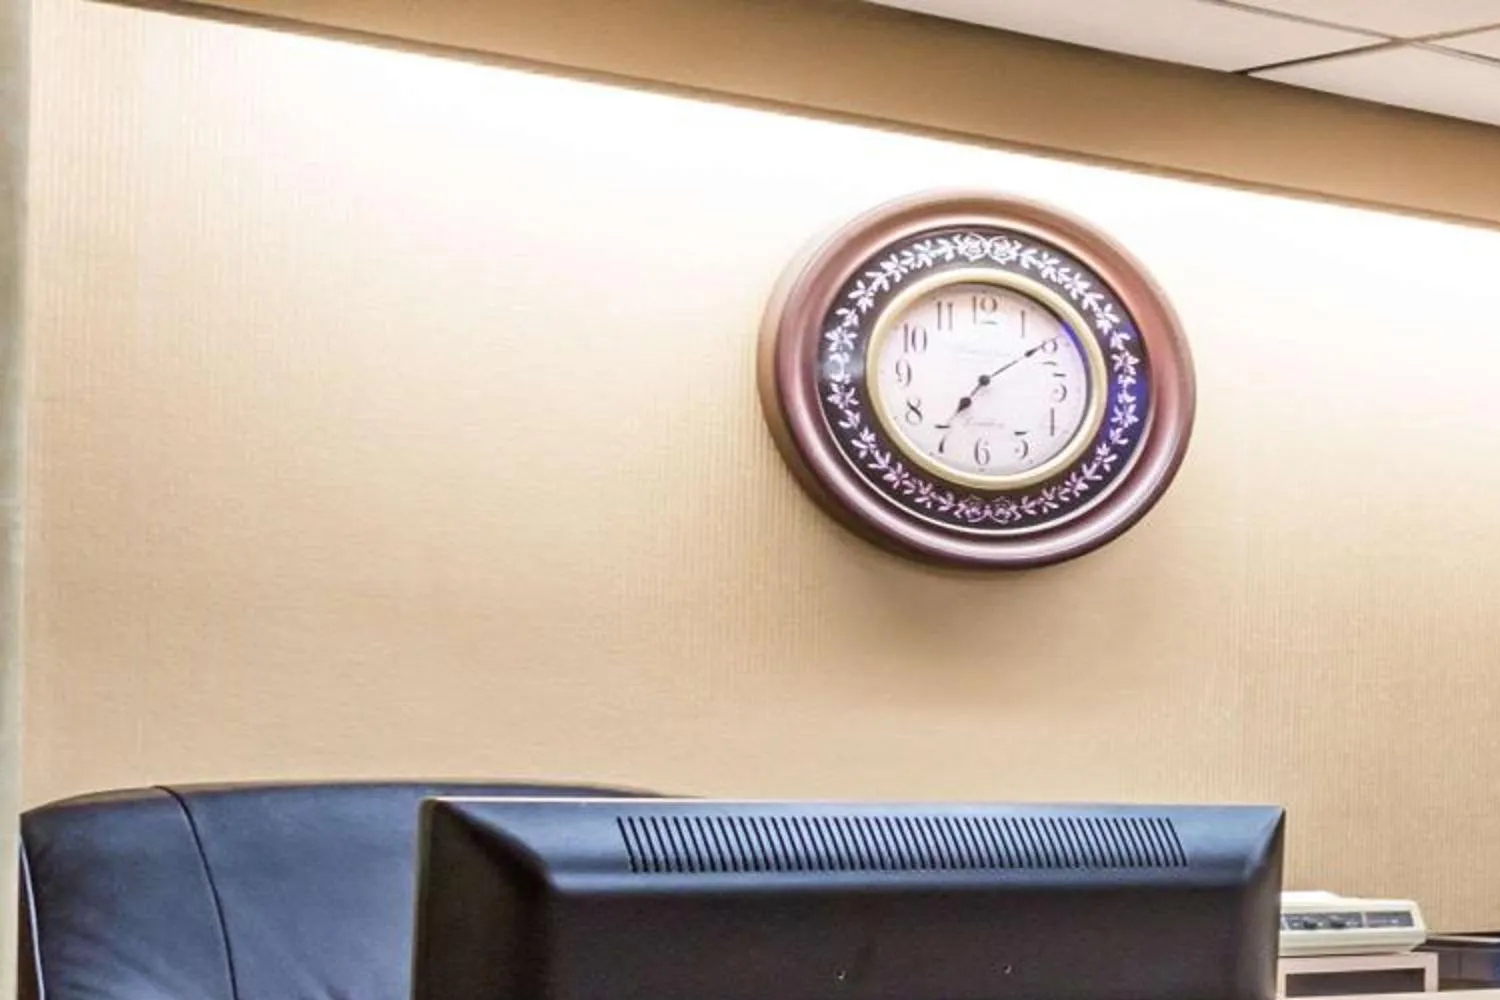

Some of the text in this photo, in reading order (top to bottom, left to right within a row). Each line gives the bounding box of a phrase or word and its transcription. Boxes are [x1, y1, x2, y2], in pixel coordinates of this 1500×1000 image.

[936, 301, 954, 332] 11
[972, 295, 999, 325] 12
[1020, 309, 1026, 339] 1
[903, 323, 928, 353] 10
[894, 359, 913, 387] 9
[1053, 372, 1068, 403] 3
[904, 397, 923, 426] 8
[934, 423, 951, 454] 7
[973, 436, 991, 466] 6
[1013, 430, 1029, 460] 5
